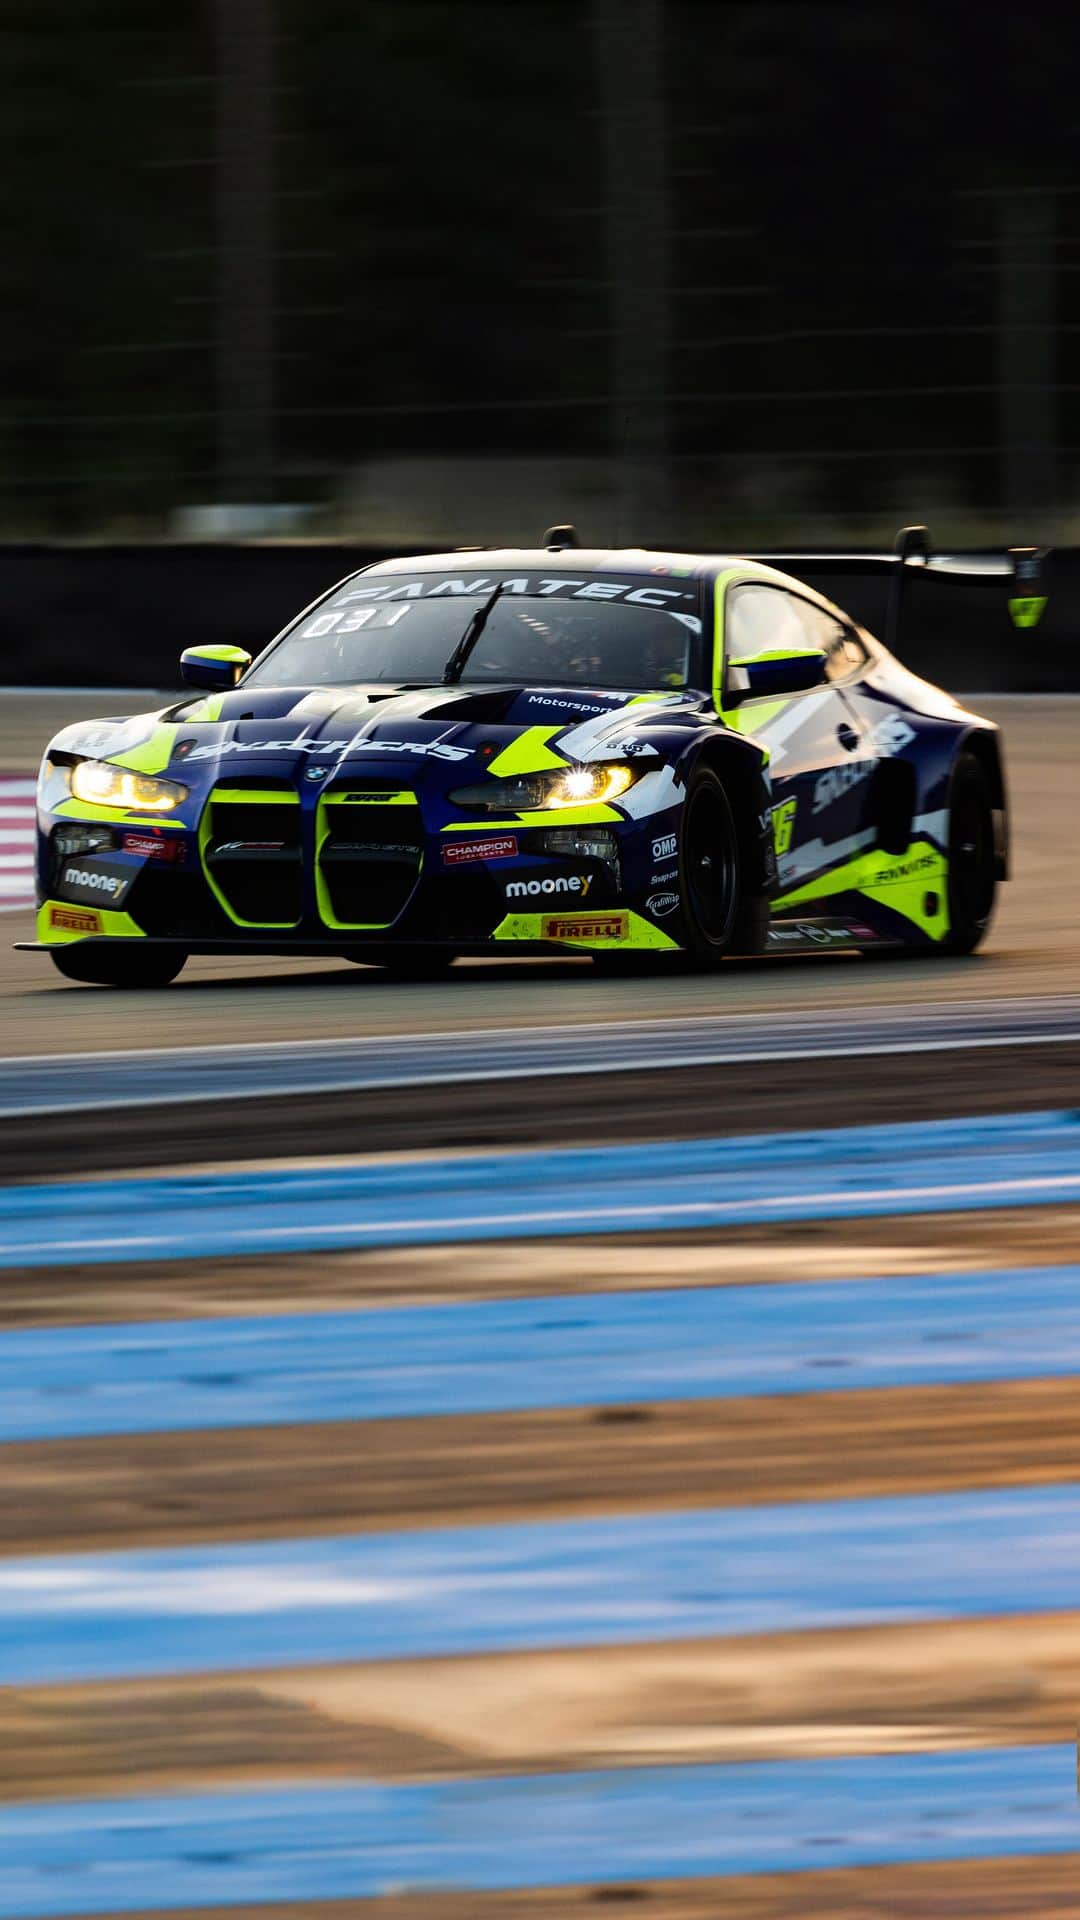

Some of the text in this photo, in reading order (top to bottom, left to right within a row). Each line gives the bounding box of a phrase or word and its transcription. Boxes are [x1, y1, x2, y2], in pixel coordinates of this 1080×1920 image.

[333, 578, 685, 607] FANATEC
[528, 695, 613, 714] Motorsport
[182, 738, 476, 762] SKECHERS
[446, 840, 513, 857] CHAMPION
[652, 837, 677, 857] OMP
[65, 868, 128, 899] mooney
[505, 874, 594, 897] mooney
[52, 908, 99, 932] PIRELLI
[548, 917, 622, 938] PIRELLI
